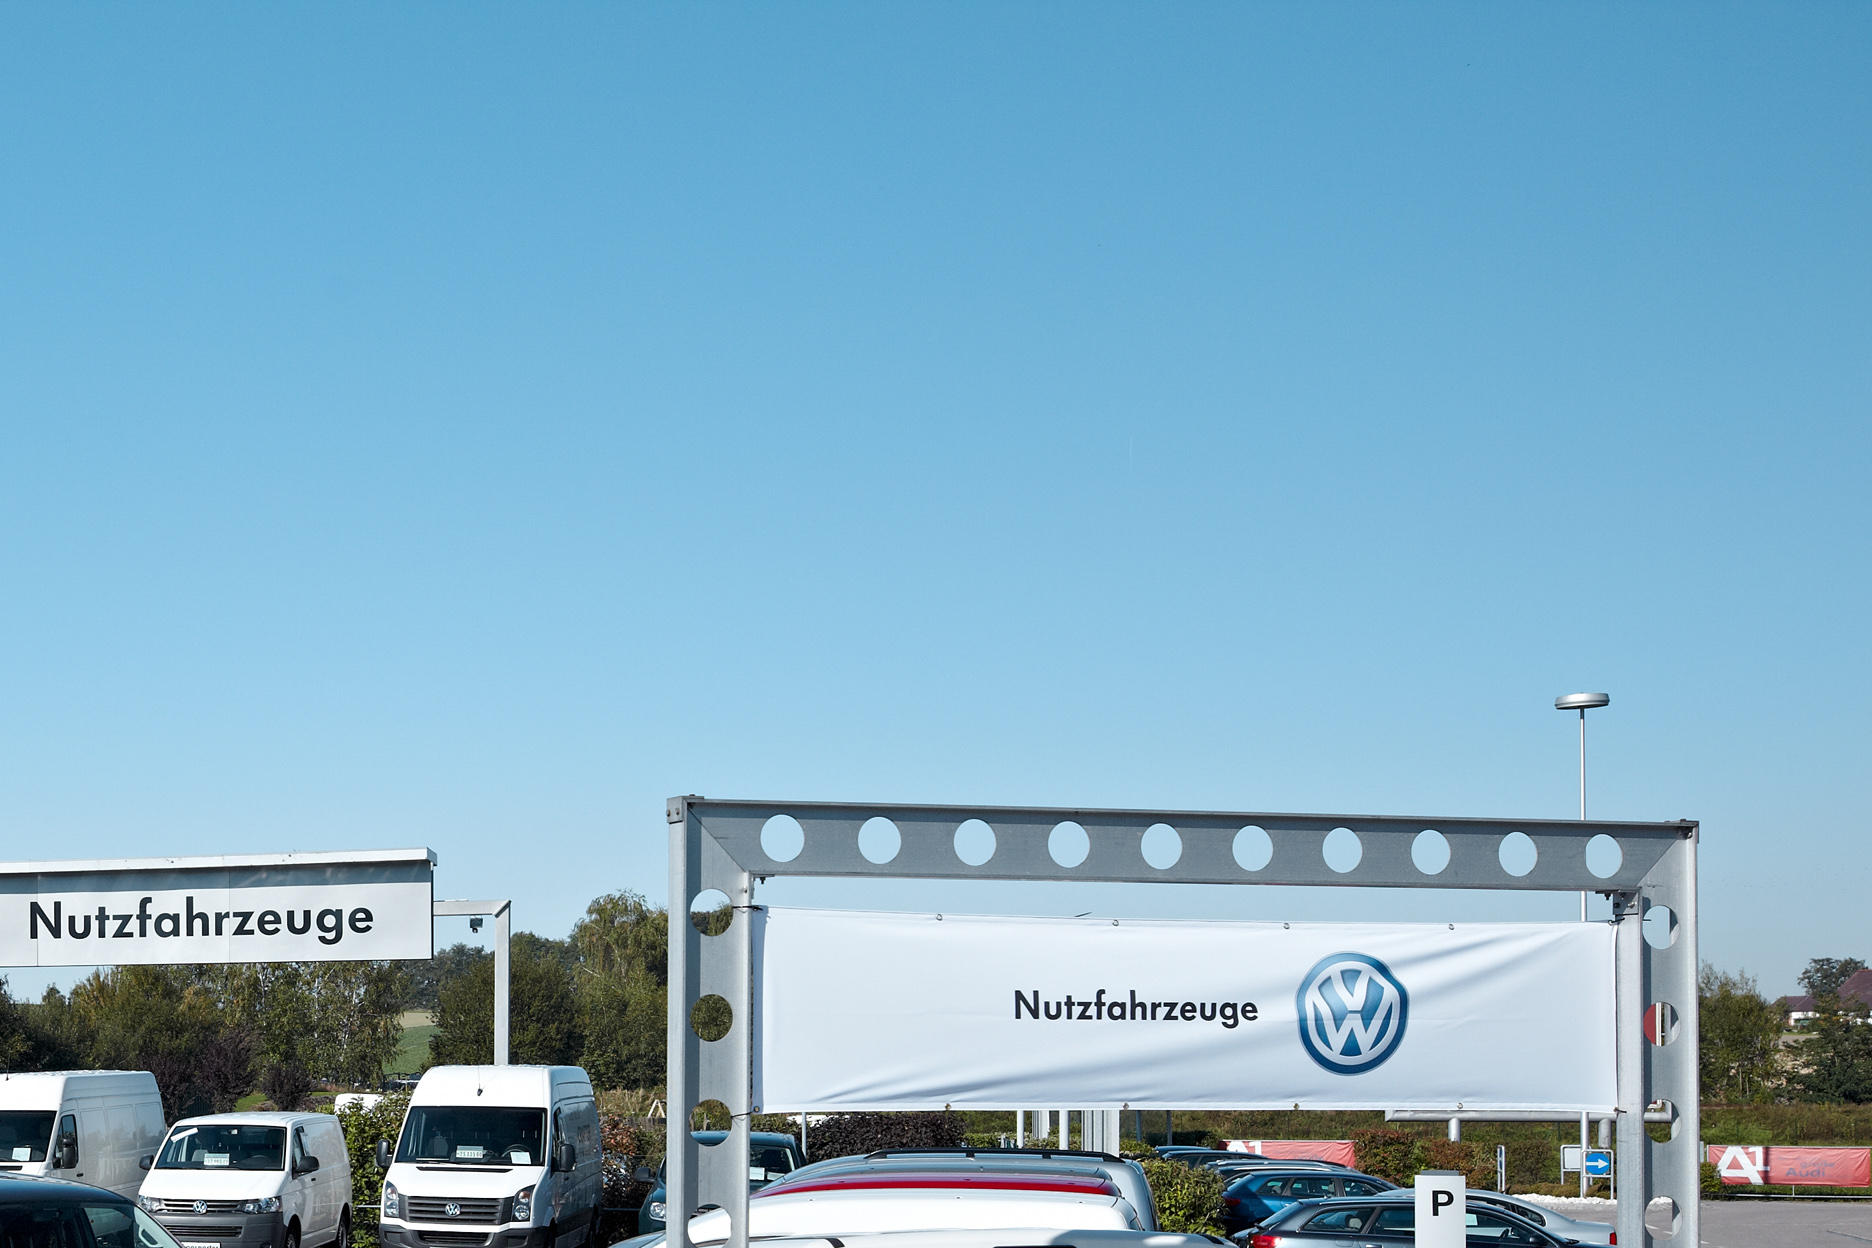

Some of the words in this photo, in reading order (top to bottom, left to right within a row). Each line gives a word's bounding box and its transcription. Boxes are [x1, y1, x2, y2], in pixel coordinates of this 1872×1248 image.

[29, 896, 374, 945] Nutzfahrzeuge
[1014, 989, 1259, 1029] Nutzfahrzeuge
[1717, 1146, 1770, 1185] A1
[1432, 1190, 1454, 1217] P
